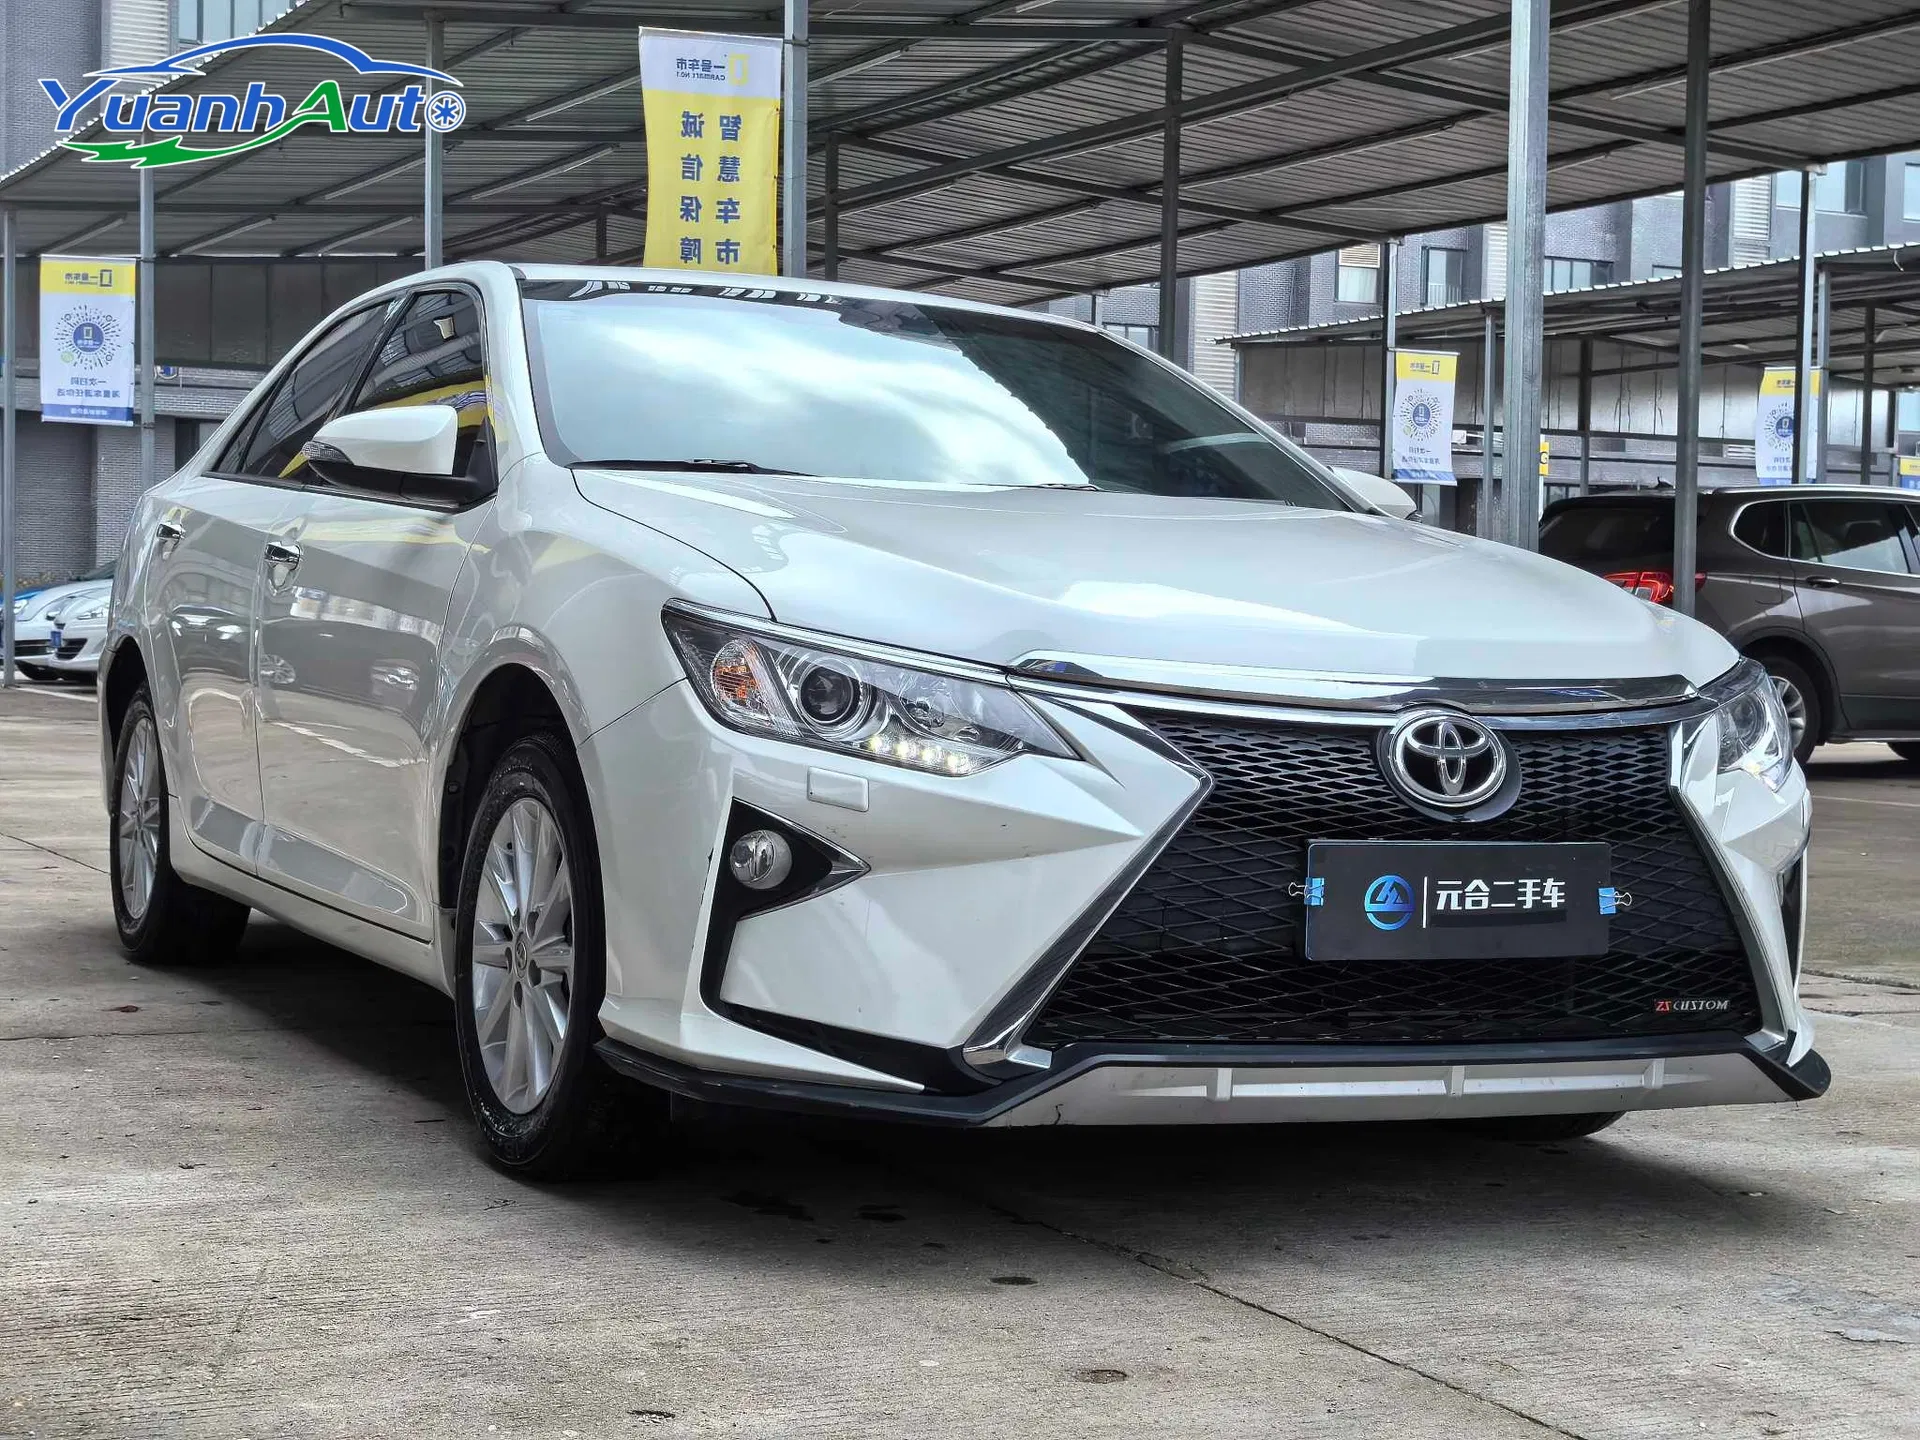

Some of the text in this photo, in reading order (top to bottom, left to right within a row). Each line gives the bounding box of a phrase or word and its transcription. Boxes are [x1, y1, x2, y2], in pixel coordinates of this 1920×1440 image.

[1435, 876, 1566, 910] 元合二手车
[1673, 1000, 1730, 1011] CUSTOM
